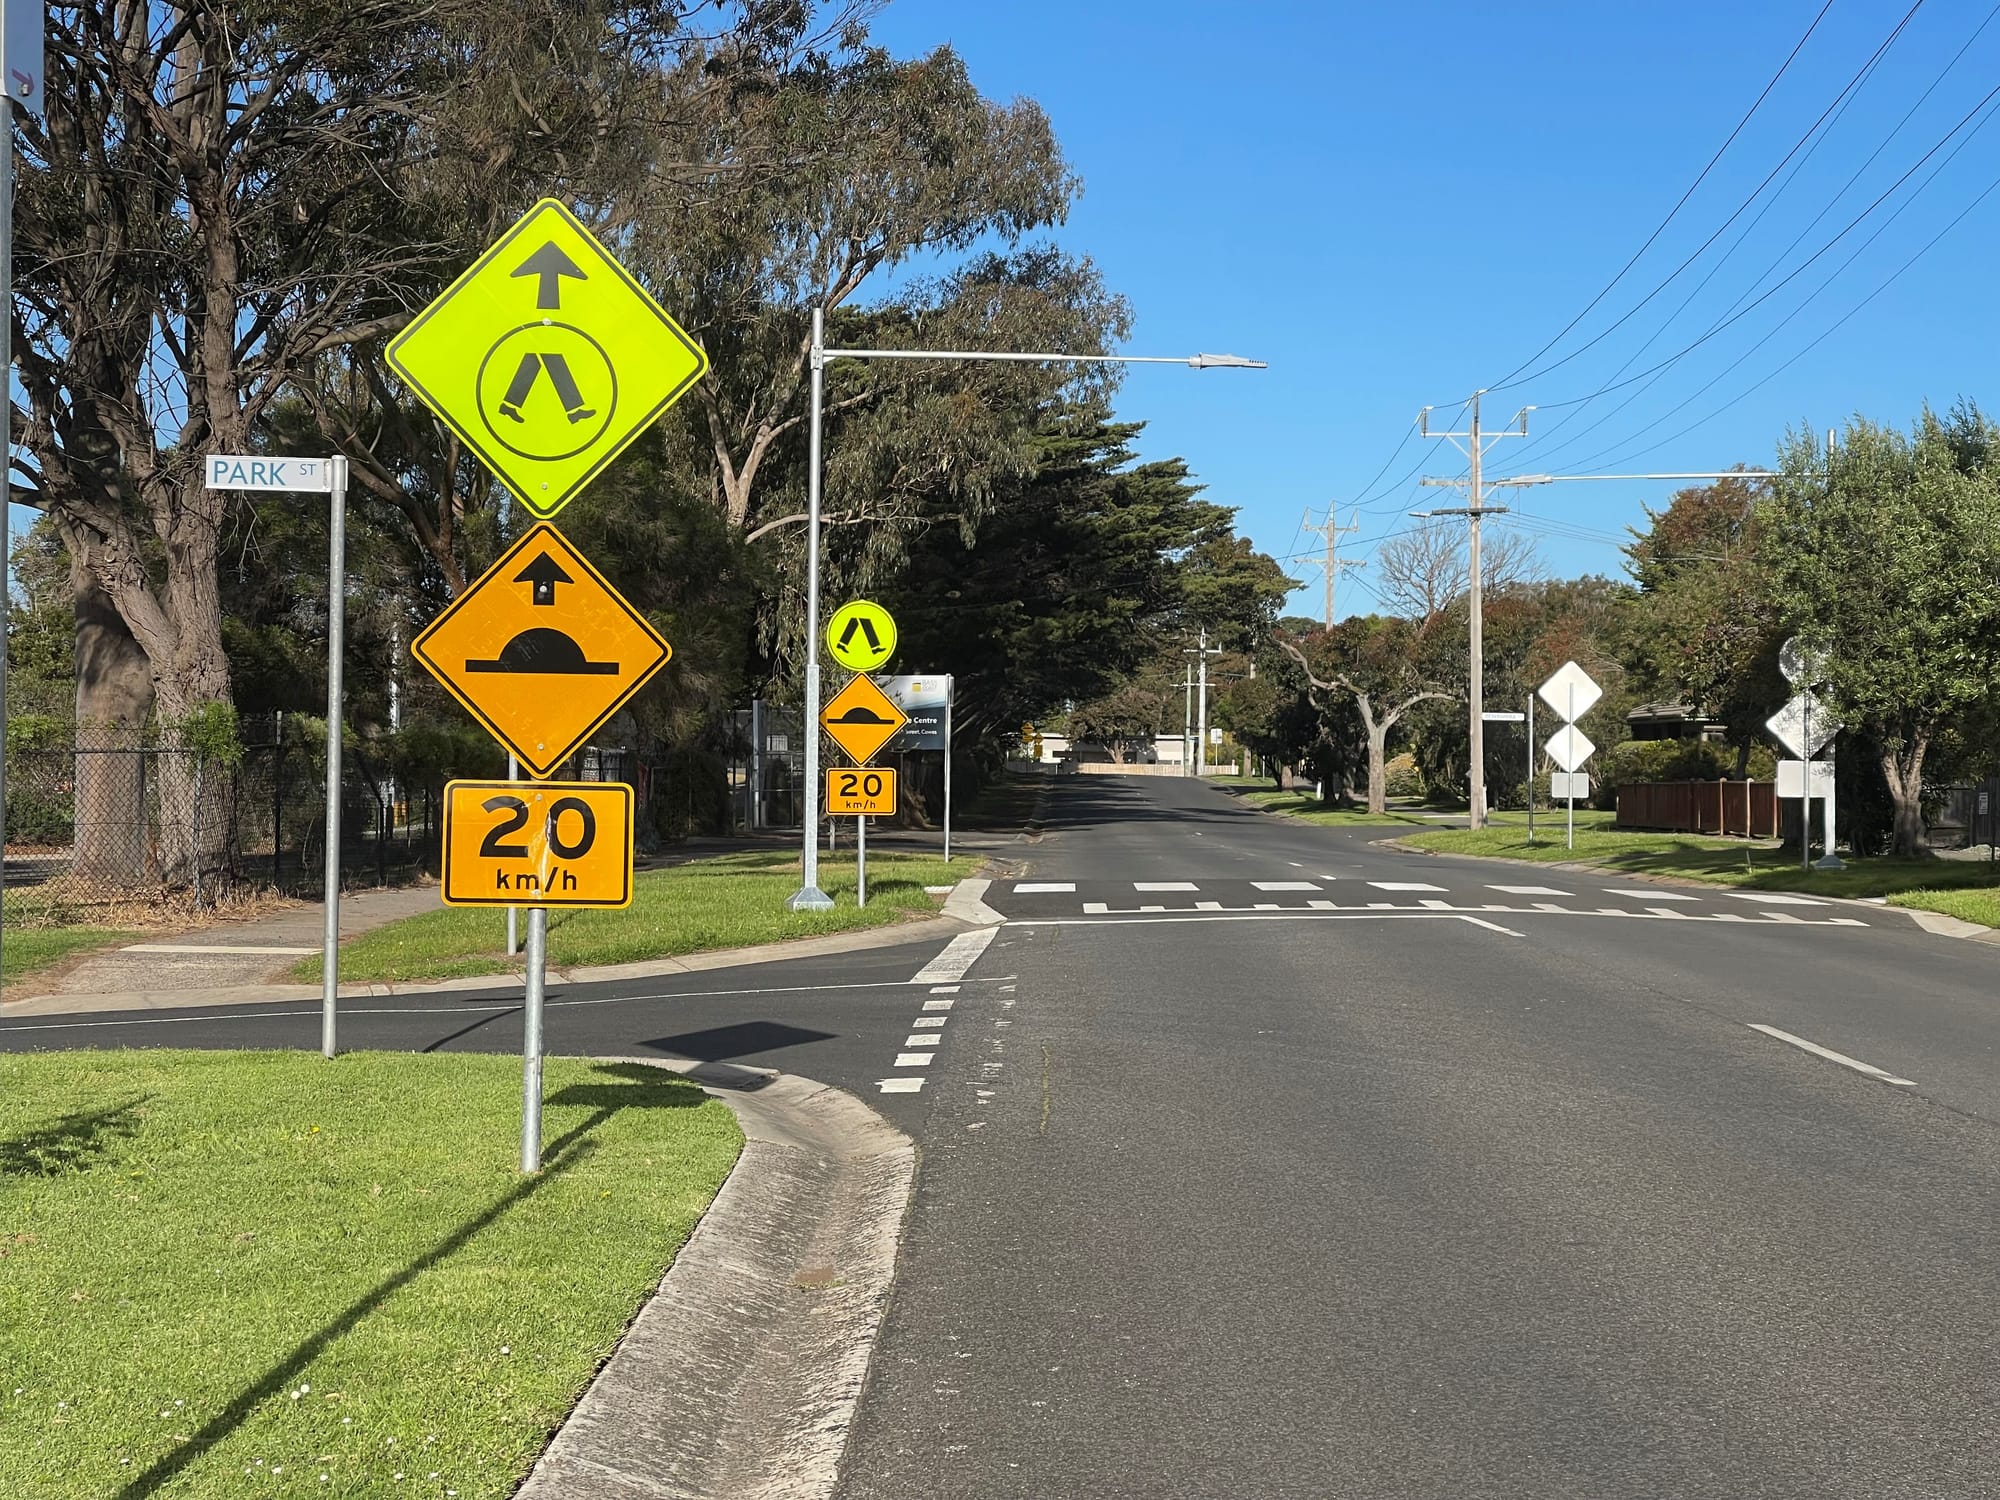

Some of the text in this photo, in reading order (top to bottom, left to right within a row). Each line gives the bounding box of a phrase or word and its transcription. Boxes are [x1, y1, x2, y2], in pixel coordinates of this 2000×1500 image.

[214, 460, 317, 486] PARK ST
[840, 774, 882, 797] 20
[846, 800, 876, 809] km/h
[479, 795, 597, 860] 20
[496, 866, 577, 893] km/h
